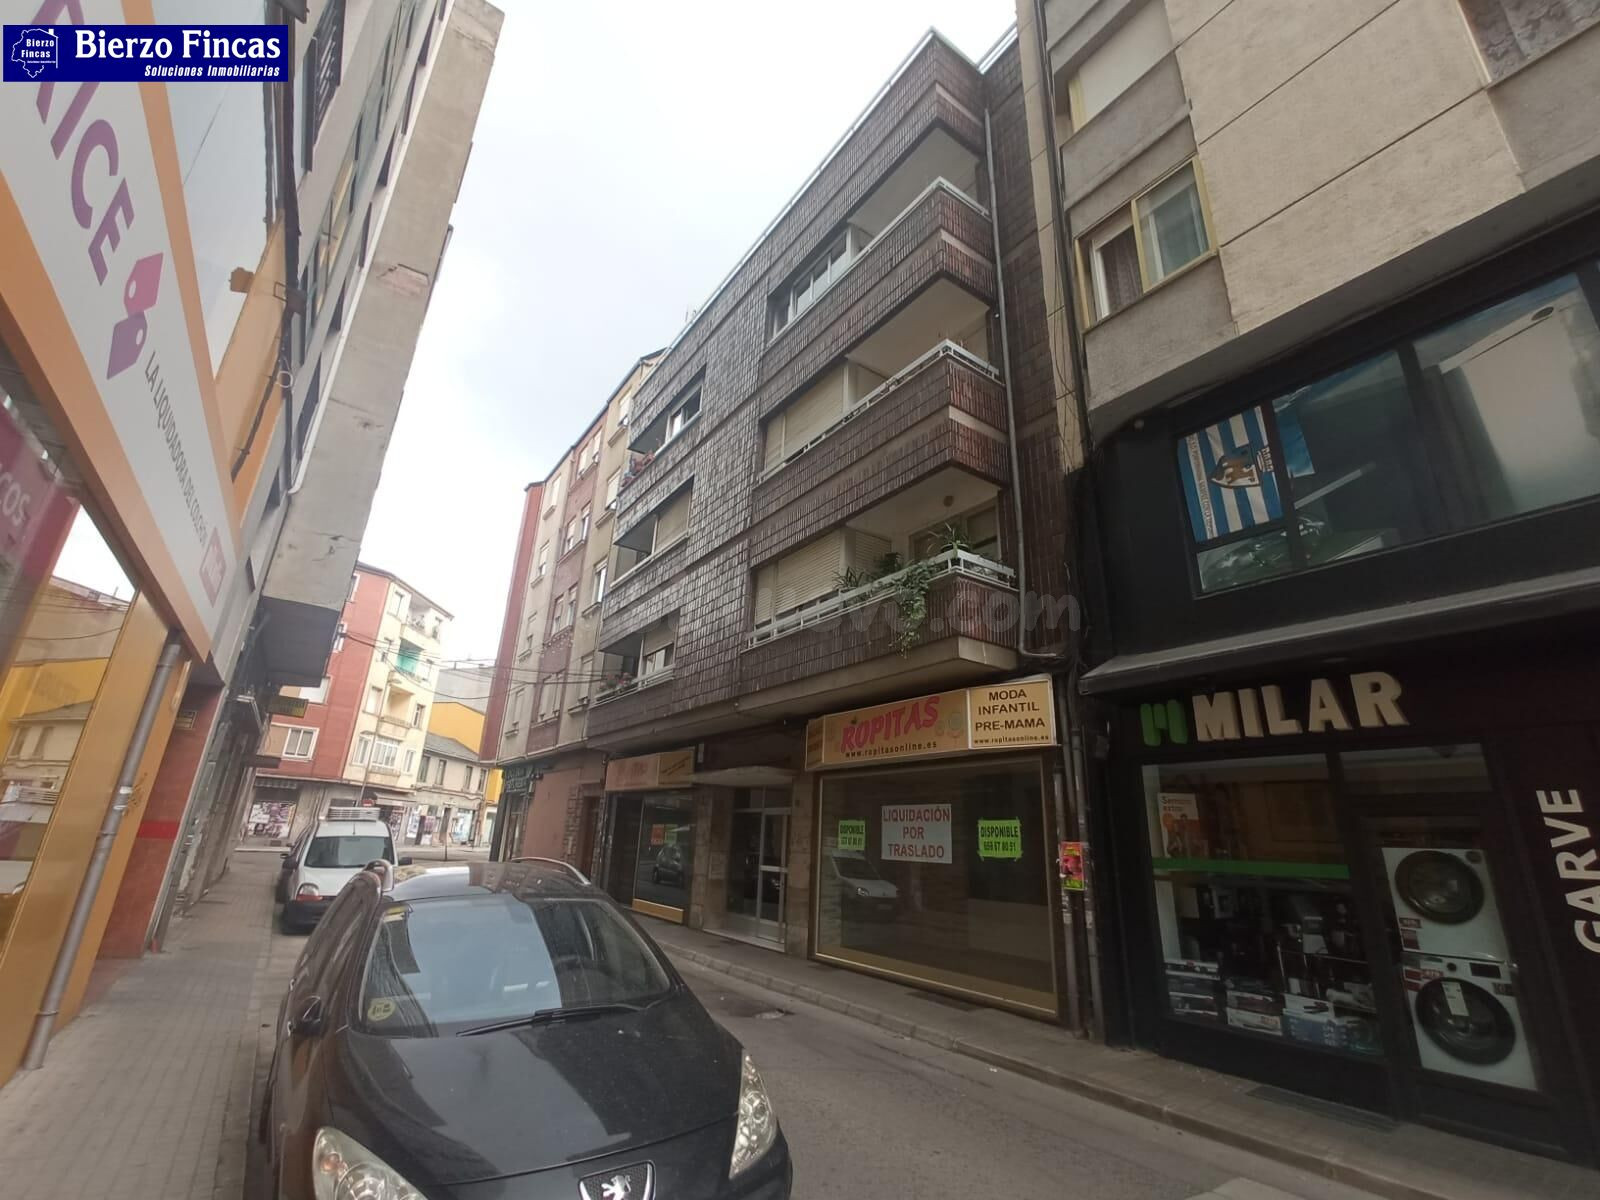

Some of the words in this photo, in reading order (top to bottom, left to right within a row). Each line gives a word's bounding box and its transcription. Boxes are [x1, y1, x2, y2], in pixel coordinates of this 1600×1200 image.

[144, 350, 160, 393] LA
[152, 379, 188, 489] LIQUIDADORA
[988, 688, 1028, 702] MODA
[978, 702, 1041, 716] INFANTIL
[1192, 671, 1410, 741] MILAR
[840, 695, 940, 753] ROPITAS
[975, 718, 1046, 732] PRE-MAMA
[974, 735, 1049, 745] www.ropitasonline.es
[845, 740, 938, 758] www.ropitasonline.es
[882, 806, 951, 822] LIQUIDACIÓN
[902, 826, 925, 840] POR
[980, 825, 1019, 838] DISPONIBLE
[888, 843, 945, 858] TRASLADO
[1535, 789, 1600, 953] GARVE
